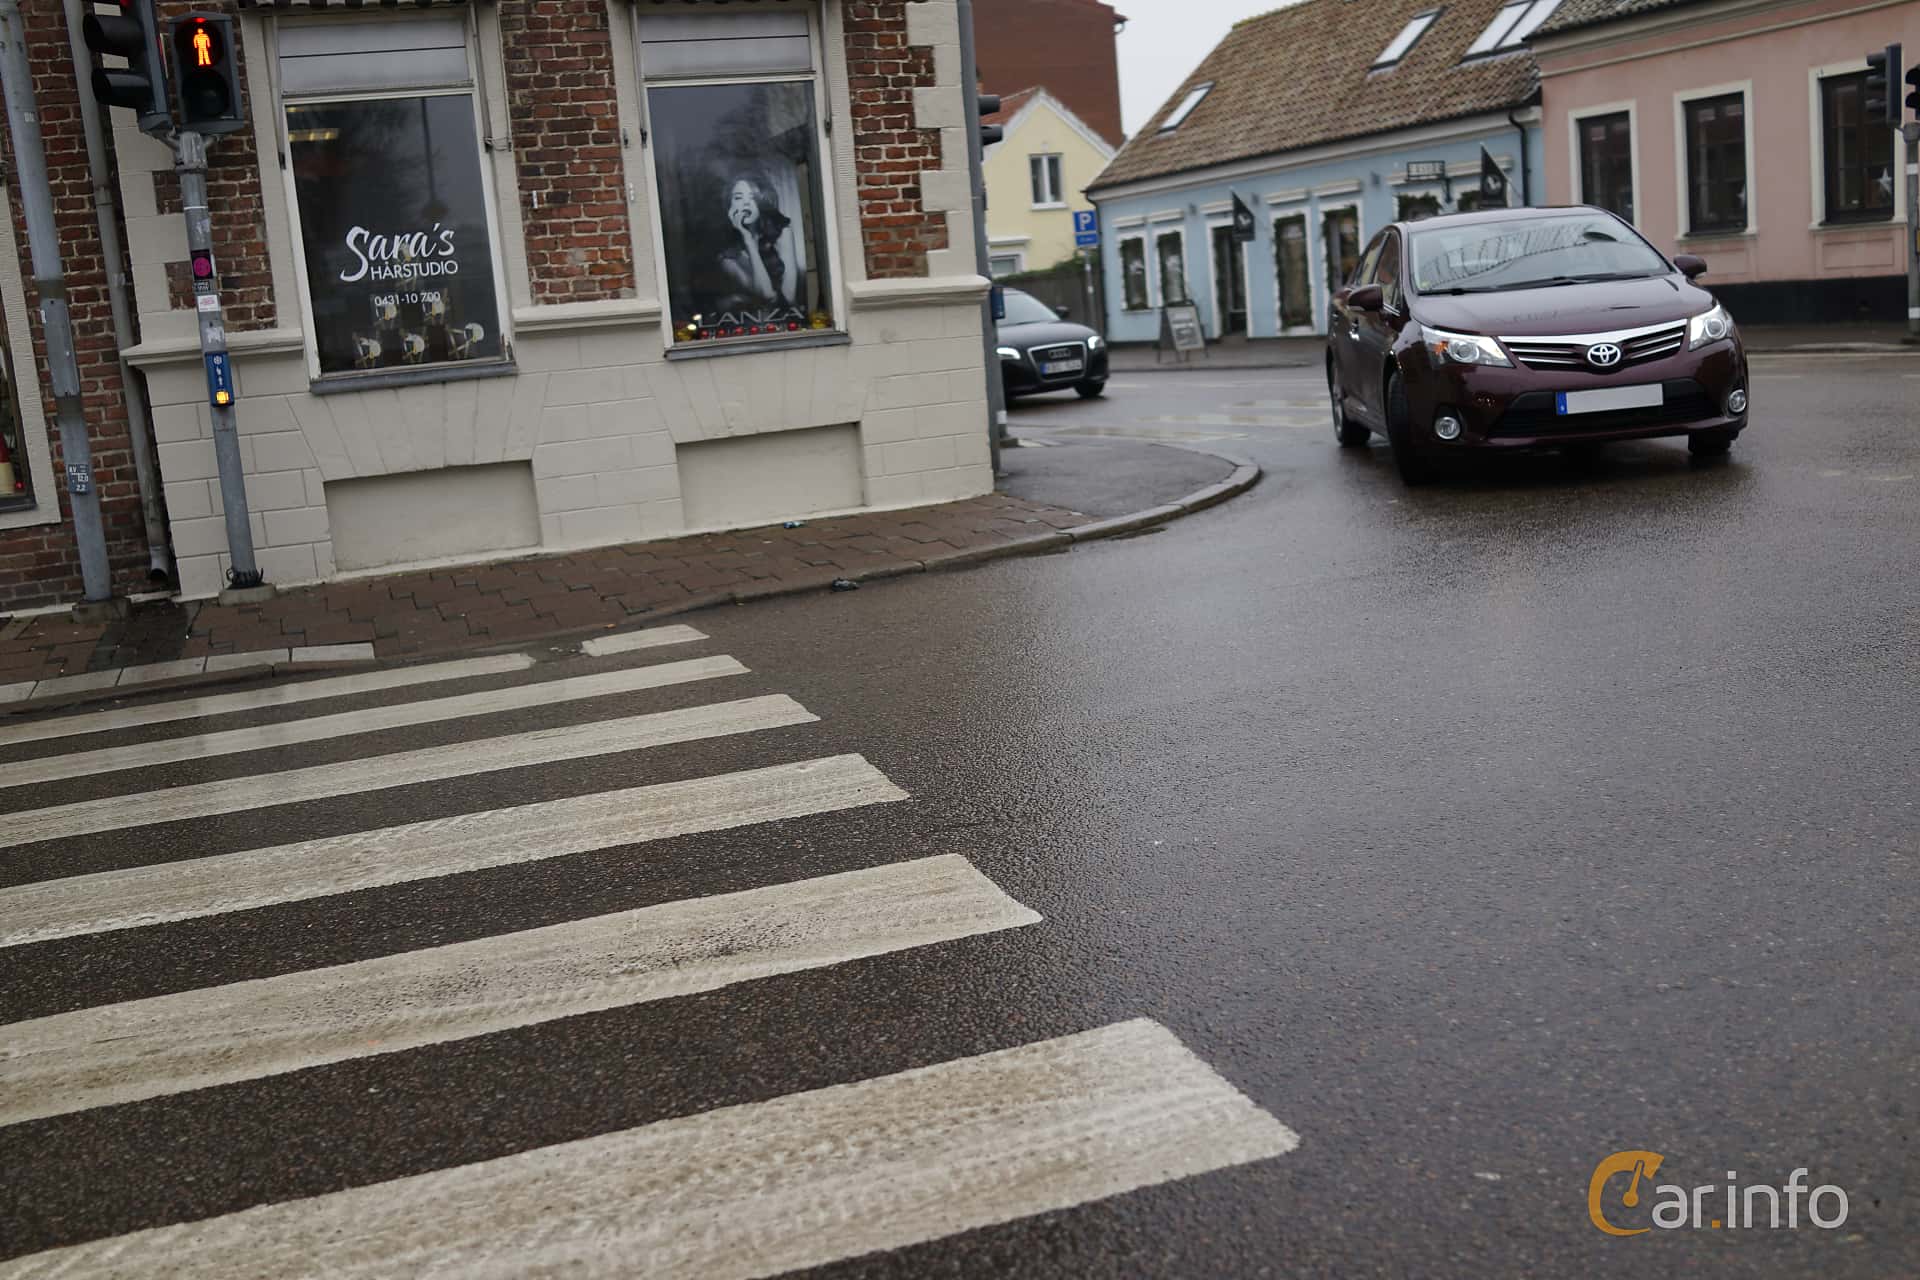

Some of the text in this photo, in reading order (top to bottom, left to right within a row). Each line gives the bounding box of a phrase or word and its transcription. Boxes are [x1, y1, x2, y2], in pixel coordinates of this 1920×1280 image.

[1079, 212, 1091, 230] P
[340, 223, 455, 281] Sara's
[371, 260, 458, 280] HÅRSTUDIO
[375, 293, 418, 306] 0431-10
